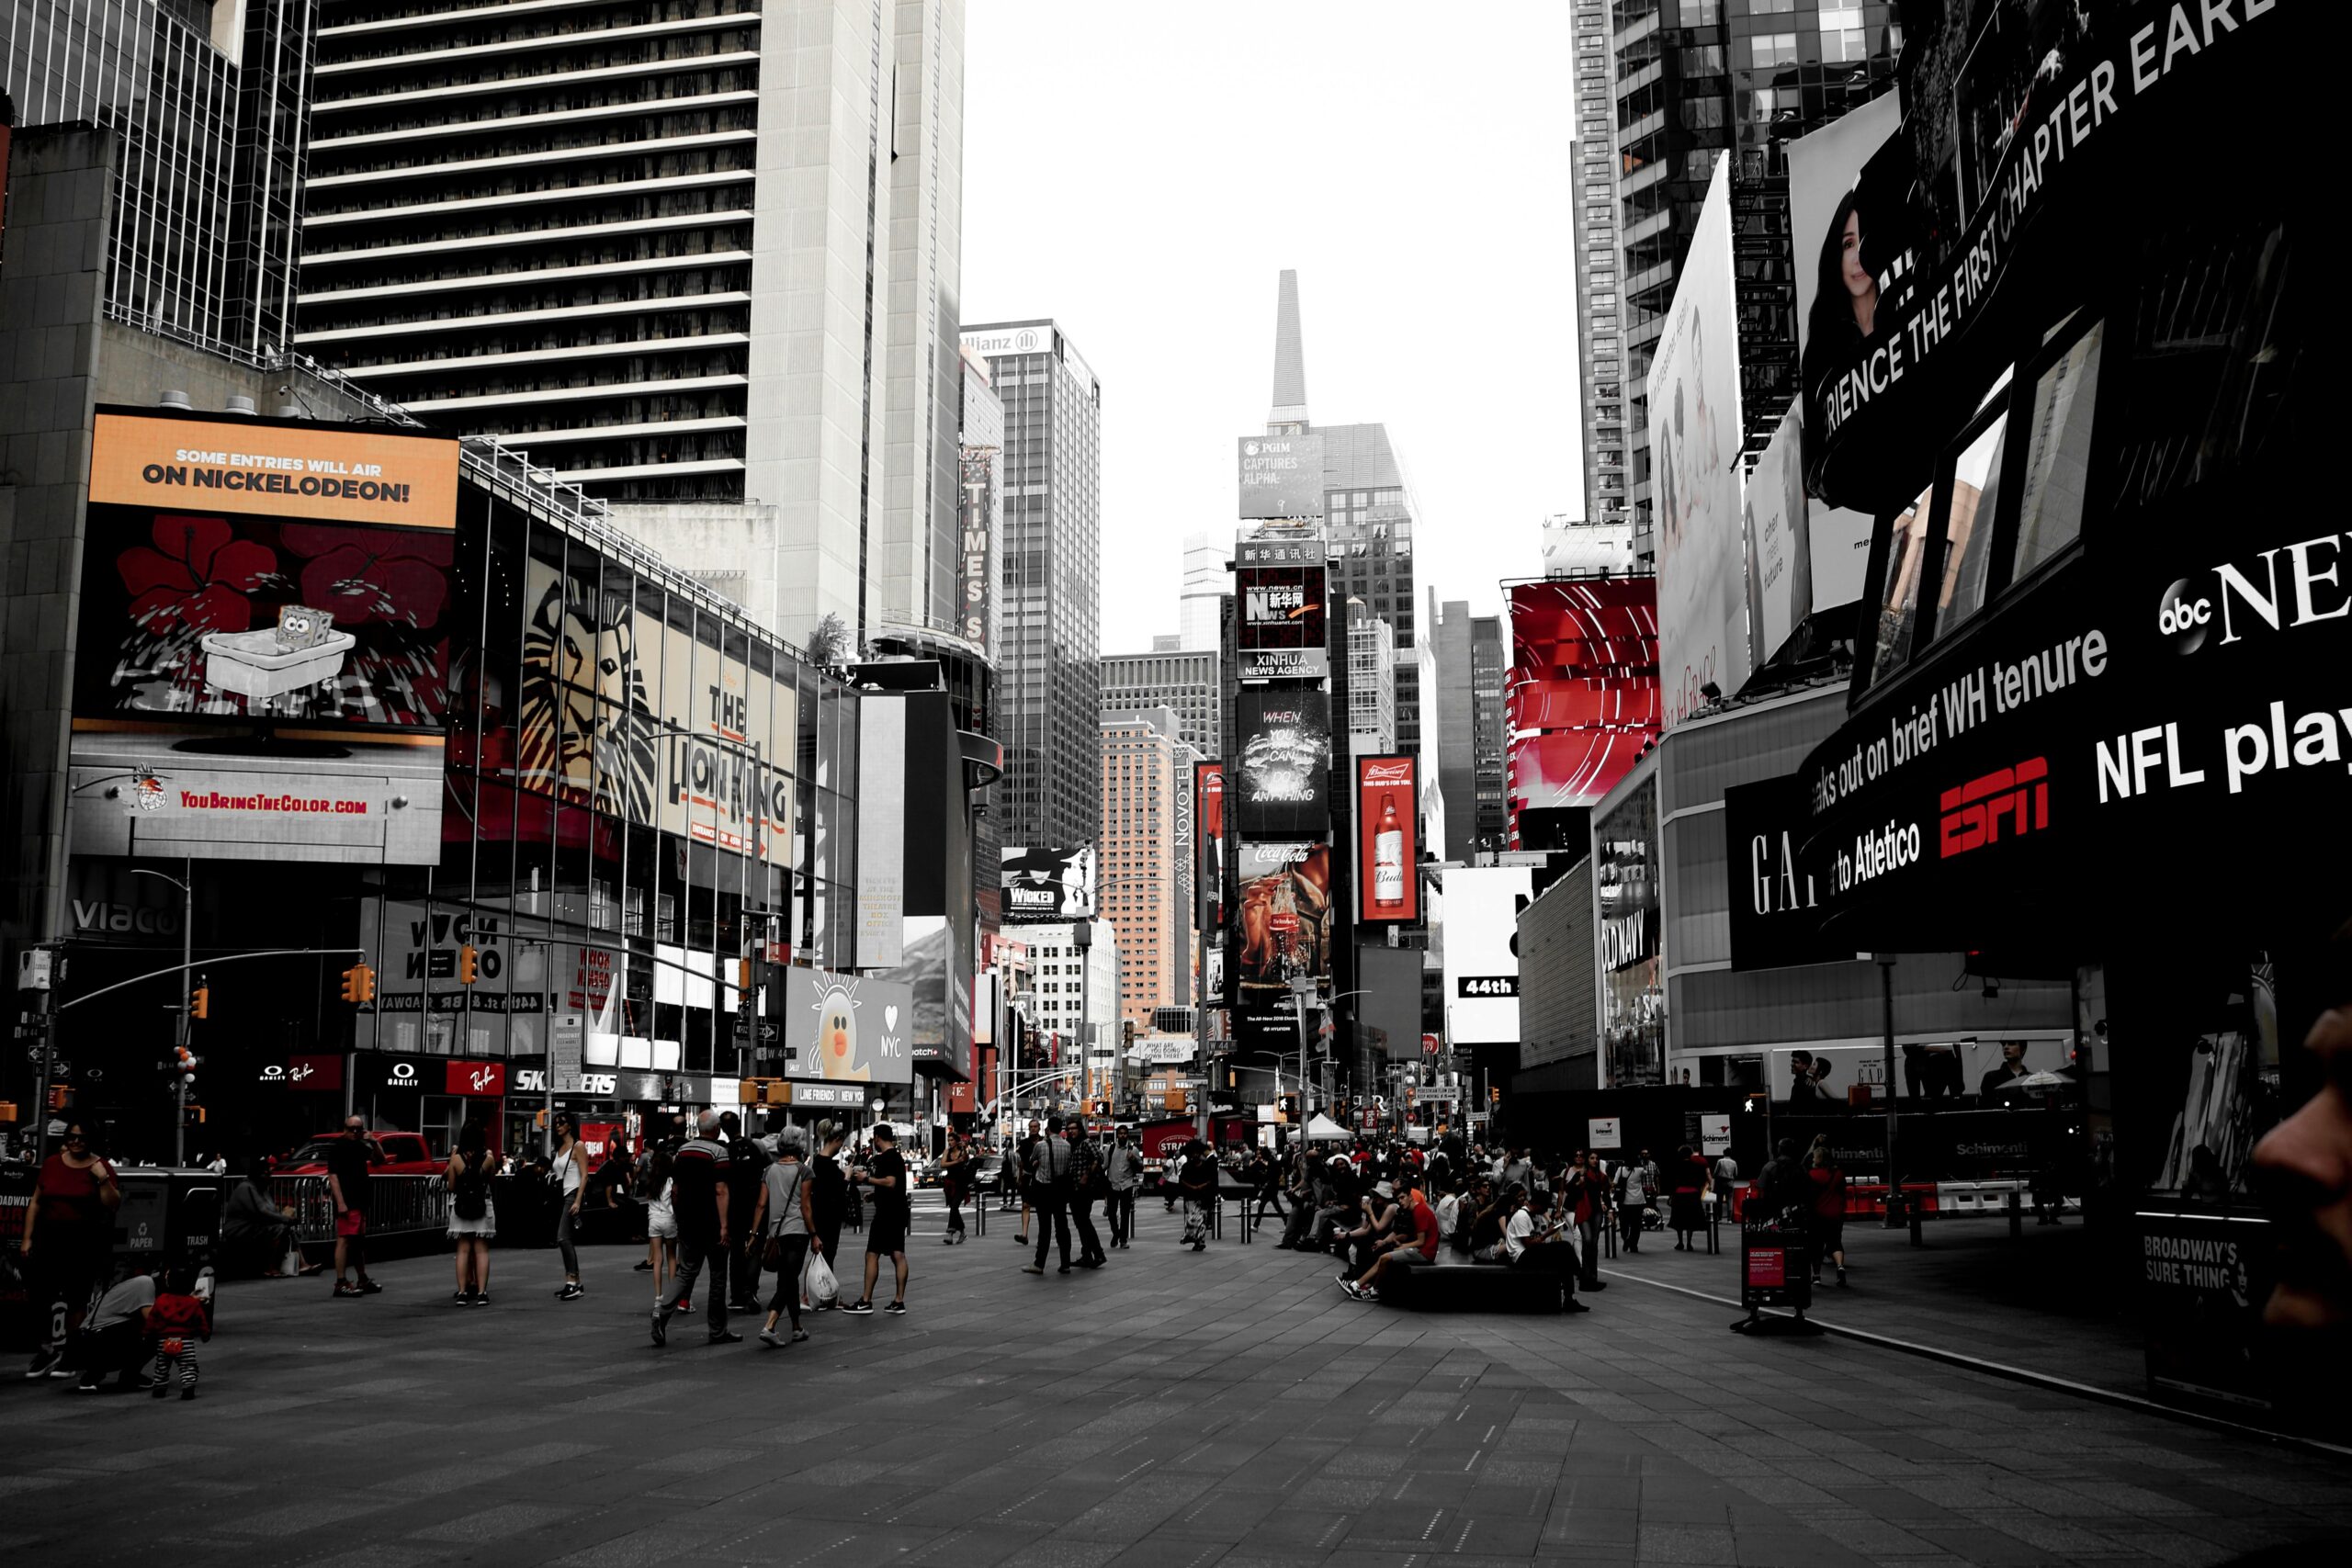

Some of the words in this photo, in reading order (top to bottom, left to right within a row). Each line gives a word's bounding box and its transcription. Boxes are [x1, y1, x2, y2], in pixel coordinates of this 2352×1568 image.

[1908, 287, 1952, 365] THE
[1953, 210, 1997, 318] FIRST
[1998, 60, 2119, 243] CHAPTER
[1262, 443, 1290, 453] PGIM
[175, 448, 228, 466] SOME
[230, 453, 304, 471] ENTRIES
[307, 458, 349, 476] WILL
[351, 463, 381, 478] AIR
[1244, 457, 1298, 470] CAPTURES
[142, 464, 187, 487] ON
[193, 468, 411, 503] NICKELODEON!
[1764, 512, 1779, 543] cher
[964, 482, 987, 603] TIMES
[1245, 548, 1317, 561] 新华通讯社
[1764, 556, 1784, 592] future
[2159, 597, 2212, 636] abc
[2211, 531, 2352, 645] NE
[1270, 592, 1303, 608] 新华网
[1257, 655, 1308, 666] XINHUA
[1245, 666, 1274, 676] NEWS
[1277, 665, 1320, 675] AGENCY
[709, 685, 746, 734] THE
[1263, 711, 1302, 723] WHEN
[1838, 745, 1864, 797] out
[1866, 735, 1889, 782] on
[1891, 700, 1939, 768] brief
[1943, 666, 1986, 739] WH
[1994, 628, 2109, 716] tenure
[1270, 729, 1295, 742] YOU
[1270, 750, 1295, 761] CAN
[2096, 721, 2206, 804] NFL
[669, 716, 728, 806] LION
[731, 745, 786, 826] KING
[1175, 758, 1190, 846] NOVOTEL
[1251, 789, 1315, 802] ANYTHING
[1939, 755, 2050, 860] ESPN
[1838, 849, 1851, 892] to
[1854, 818, 1921, 886] Atletico
[1010, 887, 1056, 904] WICKED
[1601, 925, 1617, 974] OLD
[1618, 908, 1644, 966] NAVY
[1466, 979, 1512, 994] 44th
[768, 1050, 775, 1058] W
[777, 1050, 787, 1058] 44
[881, 1035, 901, 1057] NYC
[1210, 1042, 1216, 1050] W
[1219, 1042, 1228, 1050] 44
[388, 1077, 418, 1086] OAKLEY
[1858, 1068, 1882, 1083] GAP
[799, 1089, 813, 1101] LINE
[813, 1089, 835, 1102] FRIENDS
[841, 1090, 854, 1102] NEW
[1956, 1141, 2029, 1156] Schimenti
[130, 1237, 153, 1249] PAPER
[187, 1235, 209, 1247] TRASH
[2143, 1235, 2238, 1266] BROADWAY'S
[2145, 1259, 2180, 1285] SURE
